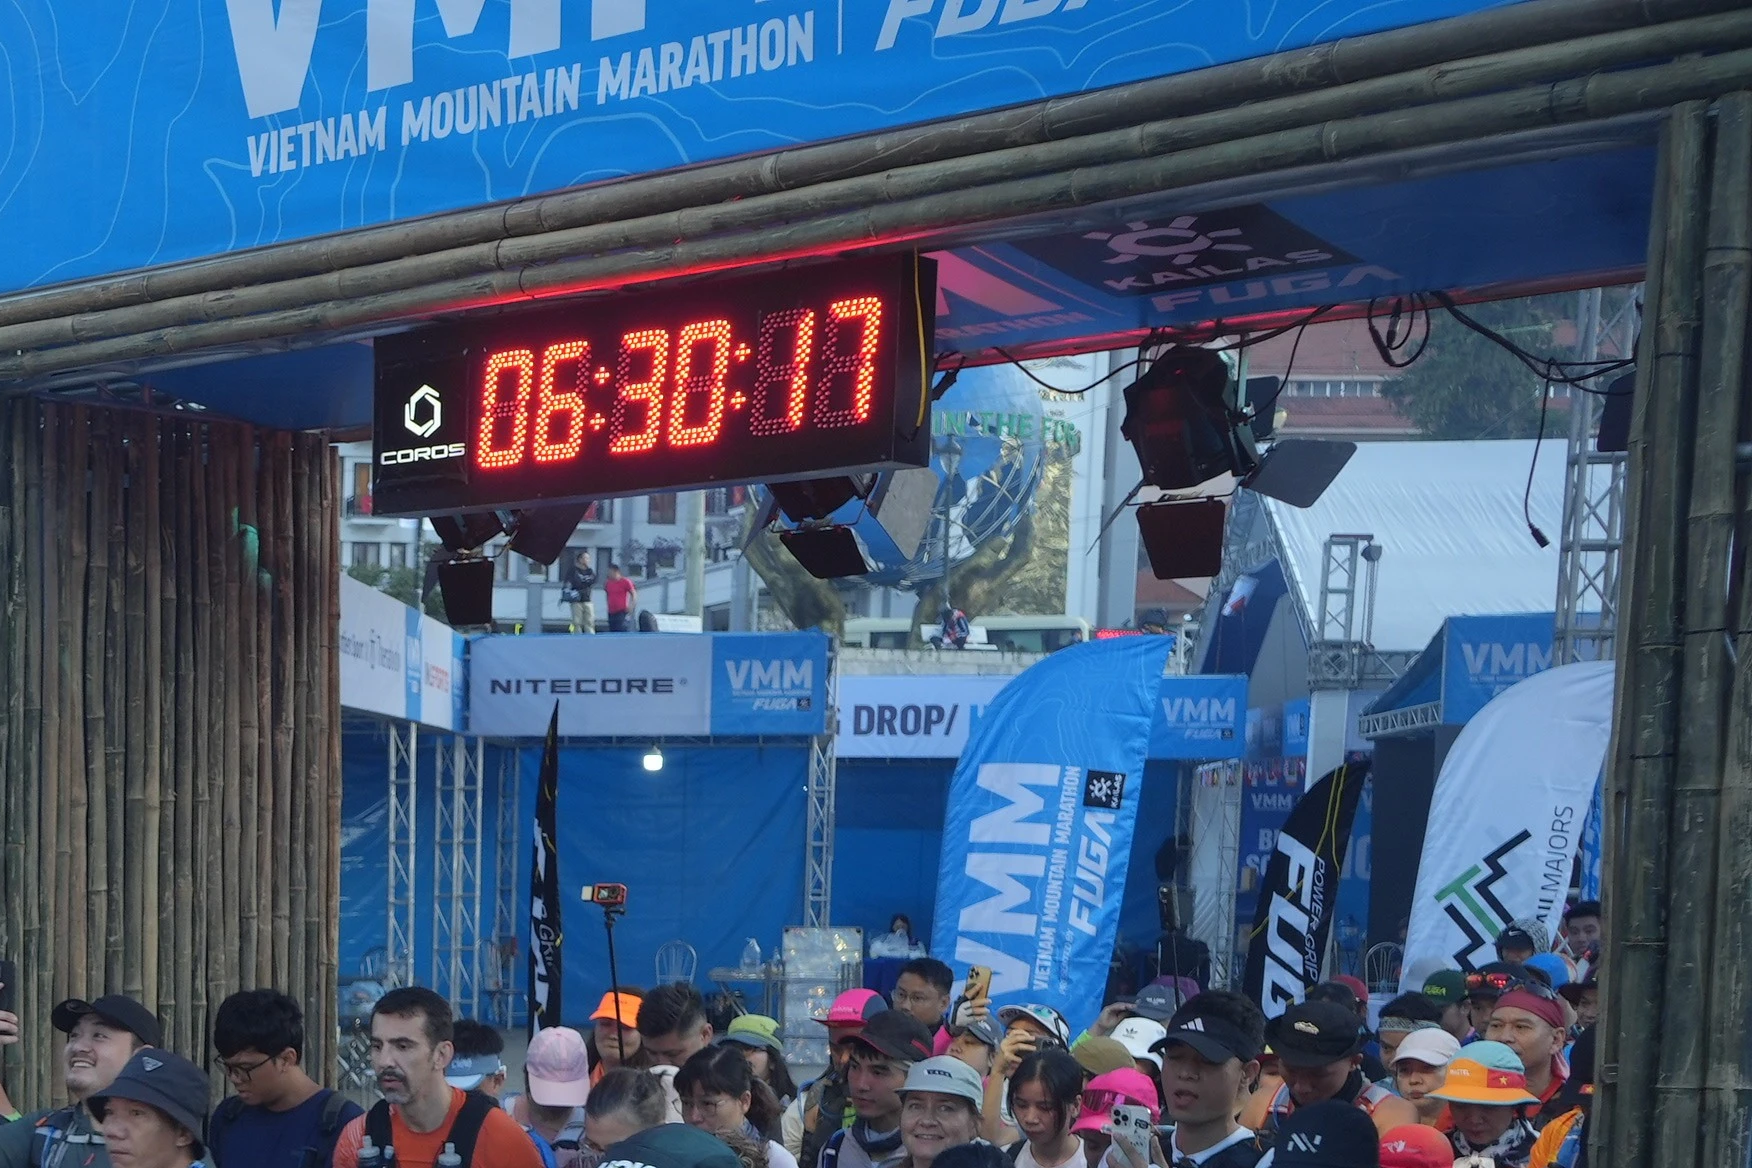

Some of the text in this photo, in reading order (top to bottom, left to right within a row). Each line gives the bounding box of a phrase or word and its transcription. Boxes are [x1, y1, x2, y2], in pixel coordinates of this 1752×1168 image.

[247, 107, 387, 178] VIETNAM
[401, 63, 581, 147] MOUNTAIN
[597, 11, 814, 105] MARATHON
[1103, 248, 1333, 292] KAILAS
[1153, 264, 1404, 312] FUGA
[477, 296, 883, 468] 06:30:17
[380, 442, 466, 466] COROS
[489, 677, 674, 696] NITECORE
[725, 659, 814, 690] VMM
[1161, 696, 1237, 722] VMM
[950, 763, 1061, 1001] VMM
[1033, 765, 1081, 992] VIETNAM MOUNTAIN MARATHON
[1069, 811, 1116, 936] FUGA
[1261, 830, 1319, 1020] FUG
[1303, 856, 1326, 982] POWER GRIP
